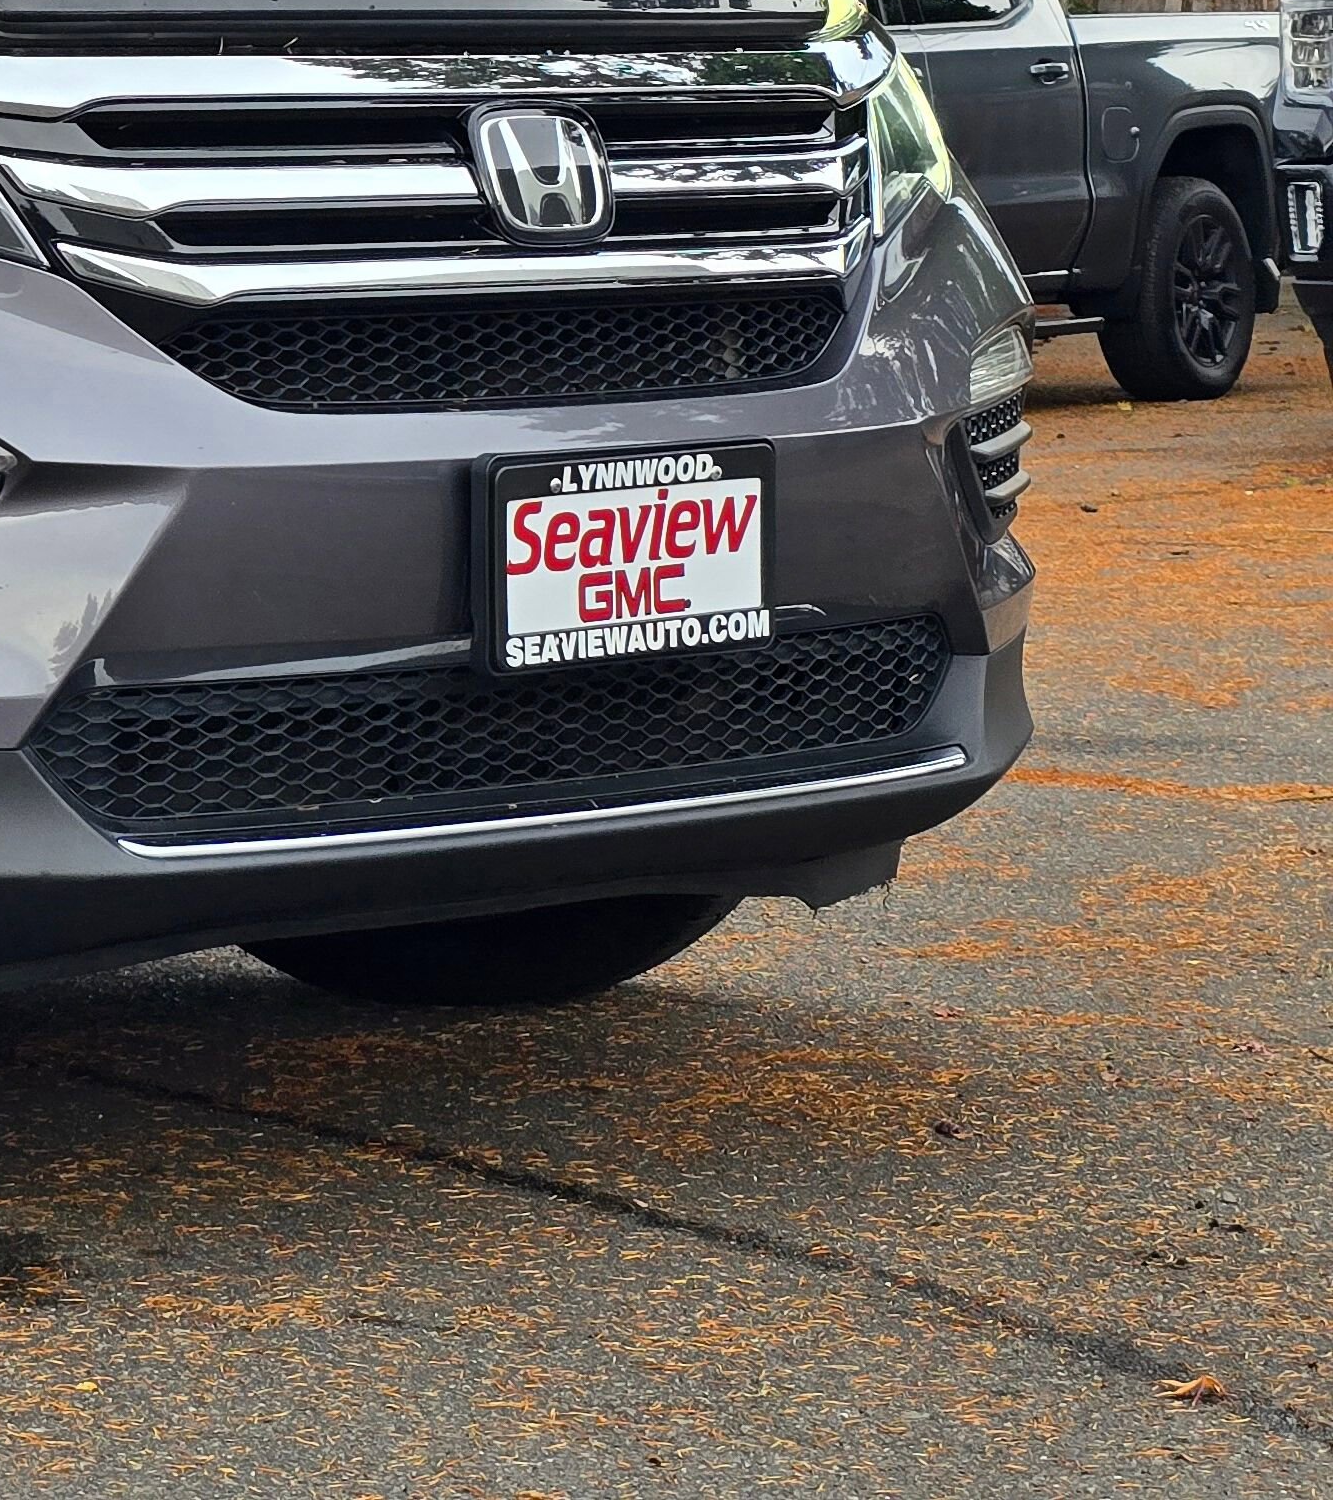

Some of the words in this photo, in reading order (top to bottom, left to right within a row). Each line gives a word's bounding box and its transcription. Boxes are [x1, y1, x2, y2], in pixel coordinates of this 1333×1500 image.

[562, 453, 714, 492] LYNNWOOD
[506, 488, 758, 575] Seaview
[578, 563, 686, 623] GMC
[505, 609, 771, 668] SEAVIEWAUTO.COM
